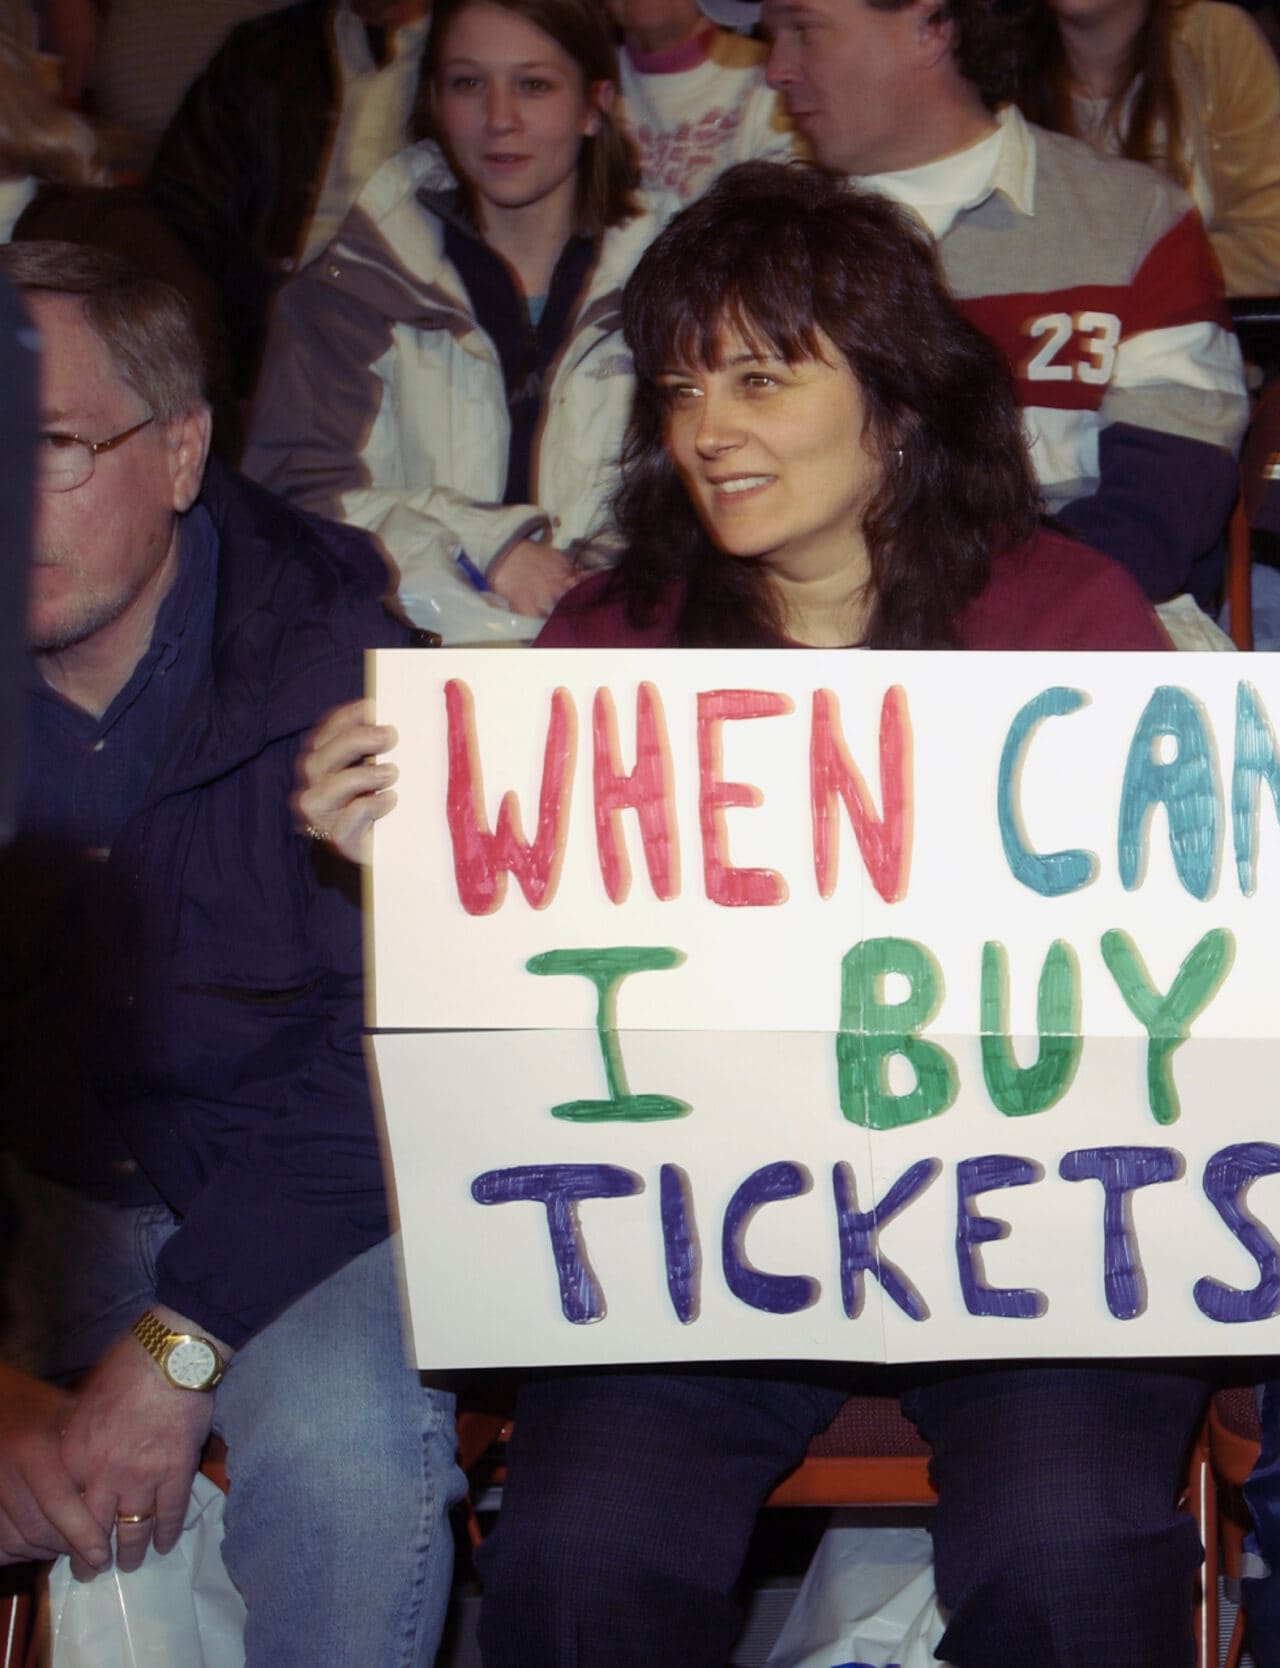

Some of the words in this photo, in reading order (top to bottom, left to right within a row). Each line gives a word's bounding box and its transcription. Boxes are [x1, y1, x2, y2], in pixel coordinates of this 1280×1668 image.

[1027, 310, 1121, 385] 23
[443, 677, 911, 917] WHEN
[525, 946, 691, 1123] I
[837, 928, 1235, 1130] BUY
